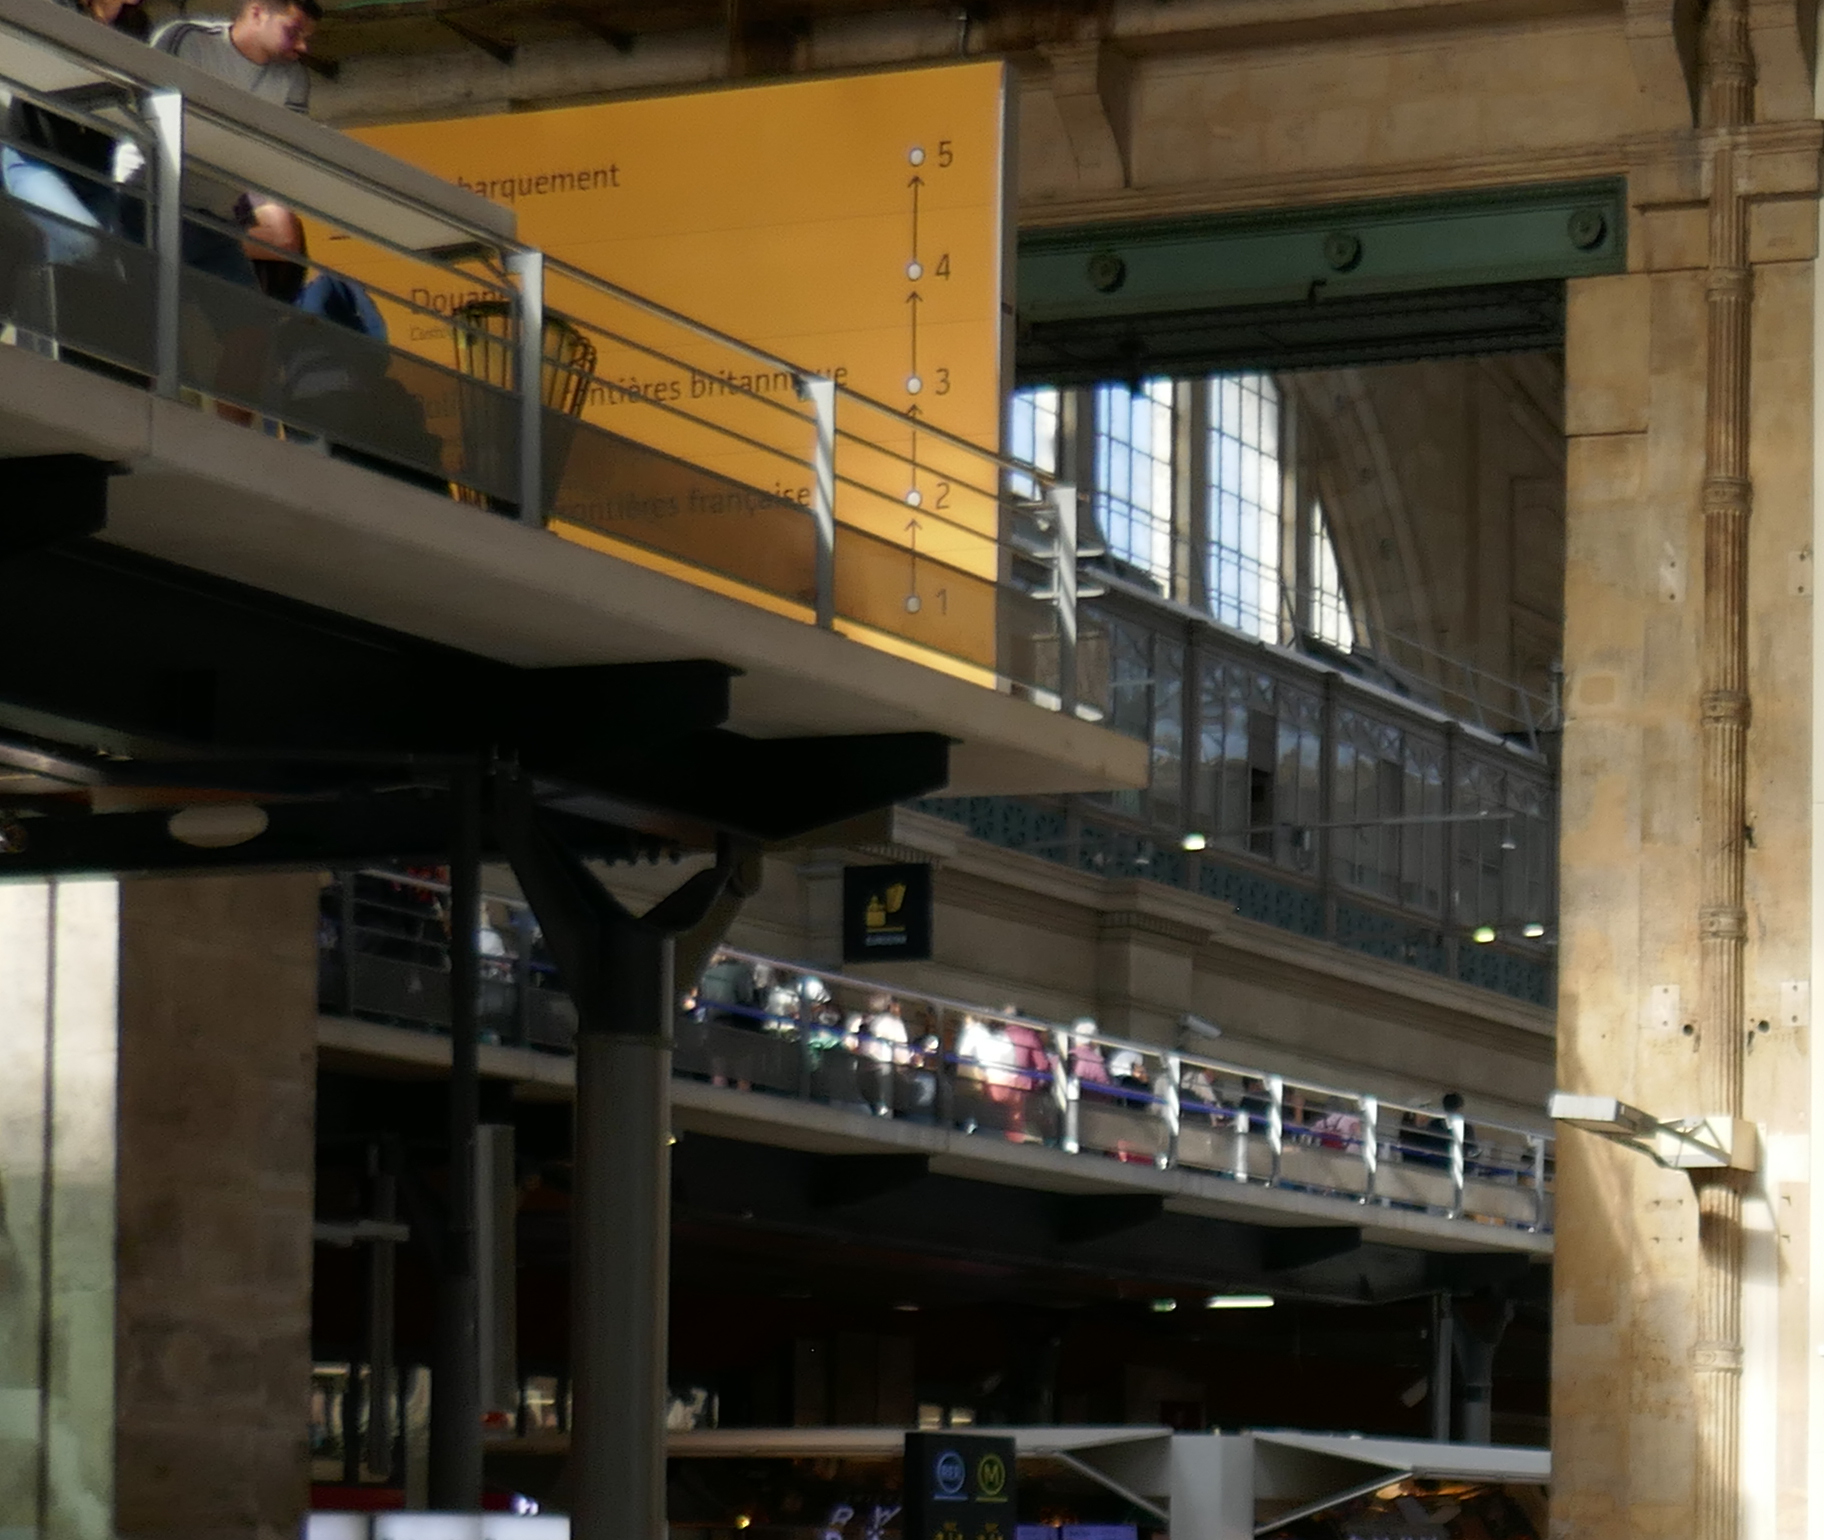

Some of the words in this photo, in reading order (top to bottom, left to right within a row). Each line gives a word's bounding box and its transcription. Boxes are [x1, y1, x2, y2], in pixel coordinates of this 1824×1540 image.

[935, 140, 954, 169] 5
[459, 163, 620, 202] barquement
[932, 252, 952, 281] 4
[932, 368, 952, 396] 3
[932, 482, 952, 511] 2
[934, 588, 950, 617] 1
